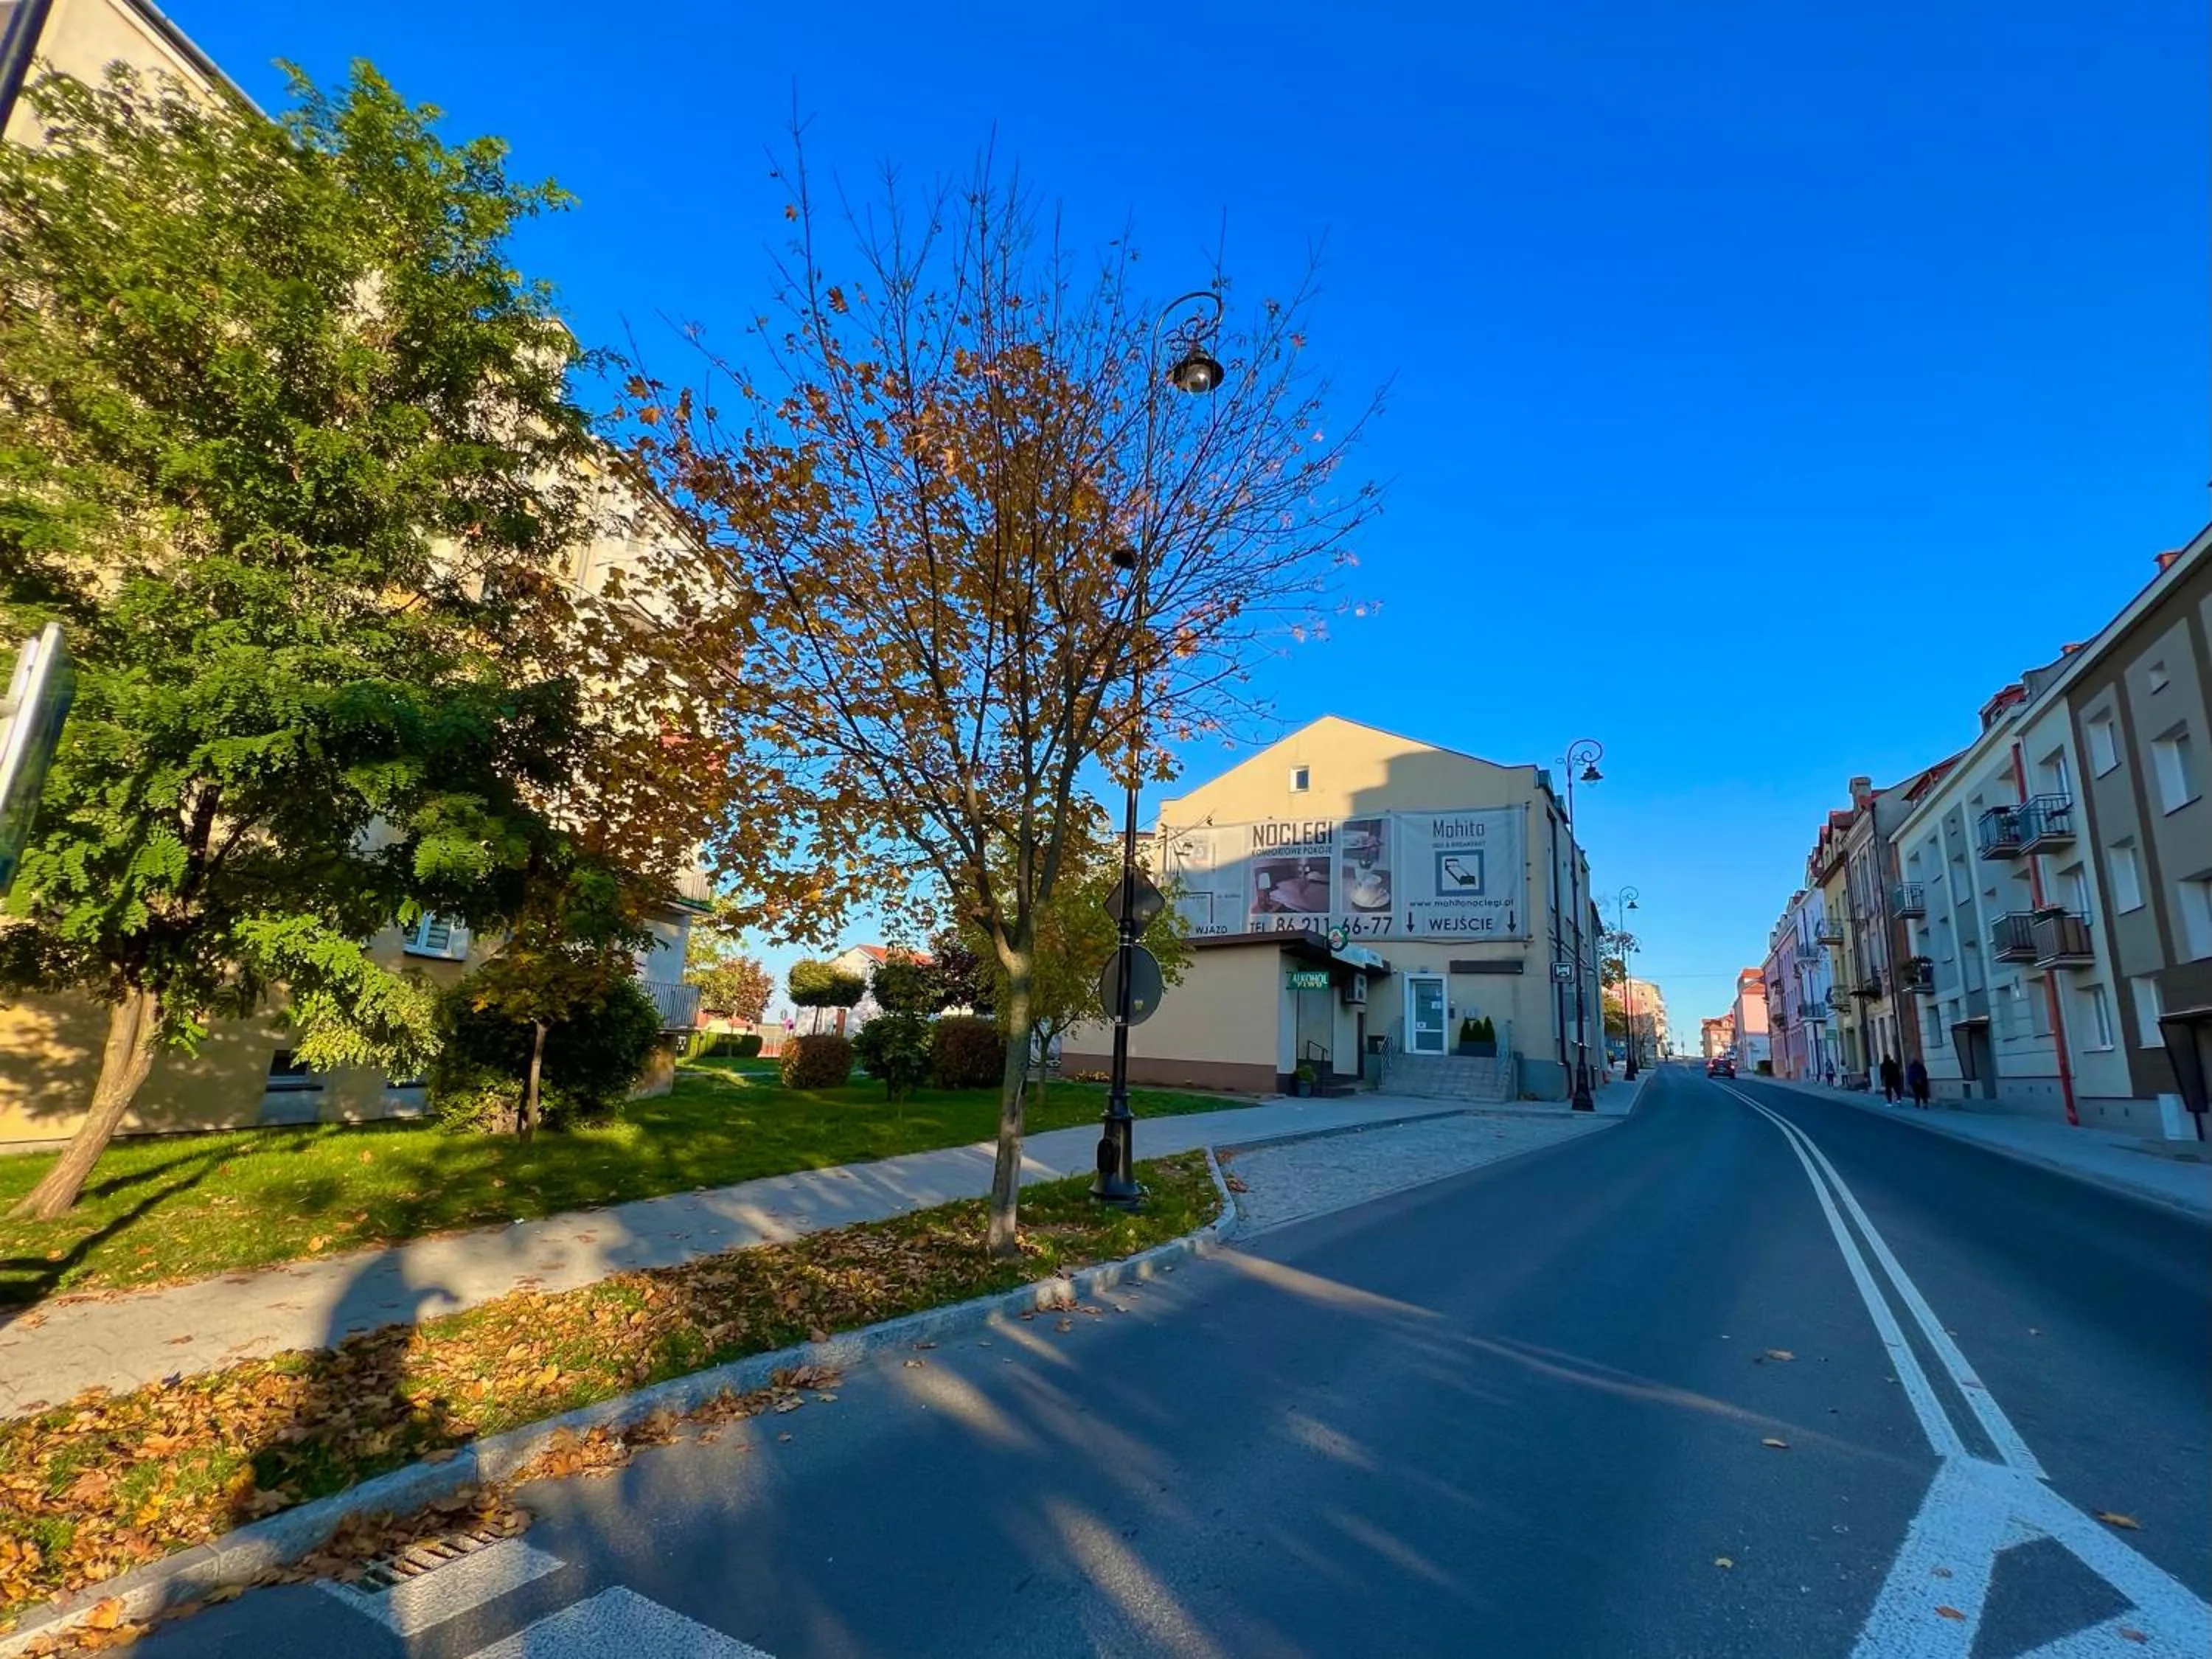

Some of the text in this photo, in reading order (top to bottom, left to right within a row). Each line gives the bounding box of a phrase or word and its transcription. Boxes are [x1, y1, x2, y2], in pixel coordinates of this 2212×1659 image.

[1253, 821, 1332, 848] NOCLEGI
[1433, 818, 1485, 838] Mohito
[1429, 915, 1493, 931] WEJŚCIE
